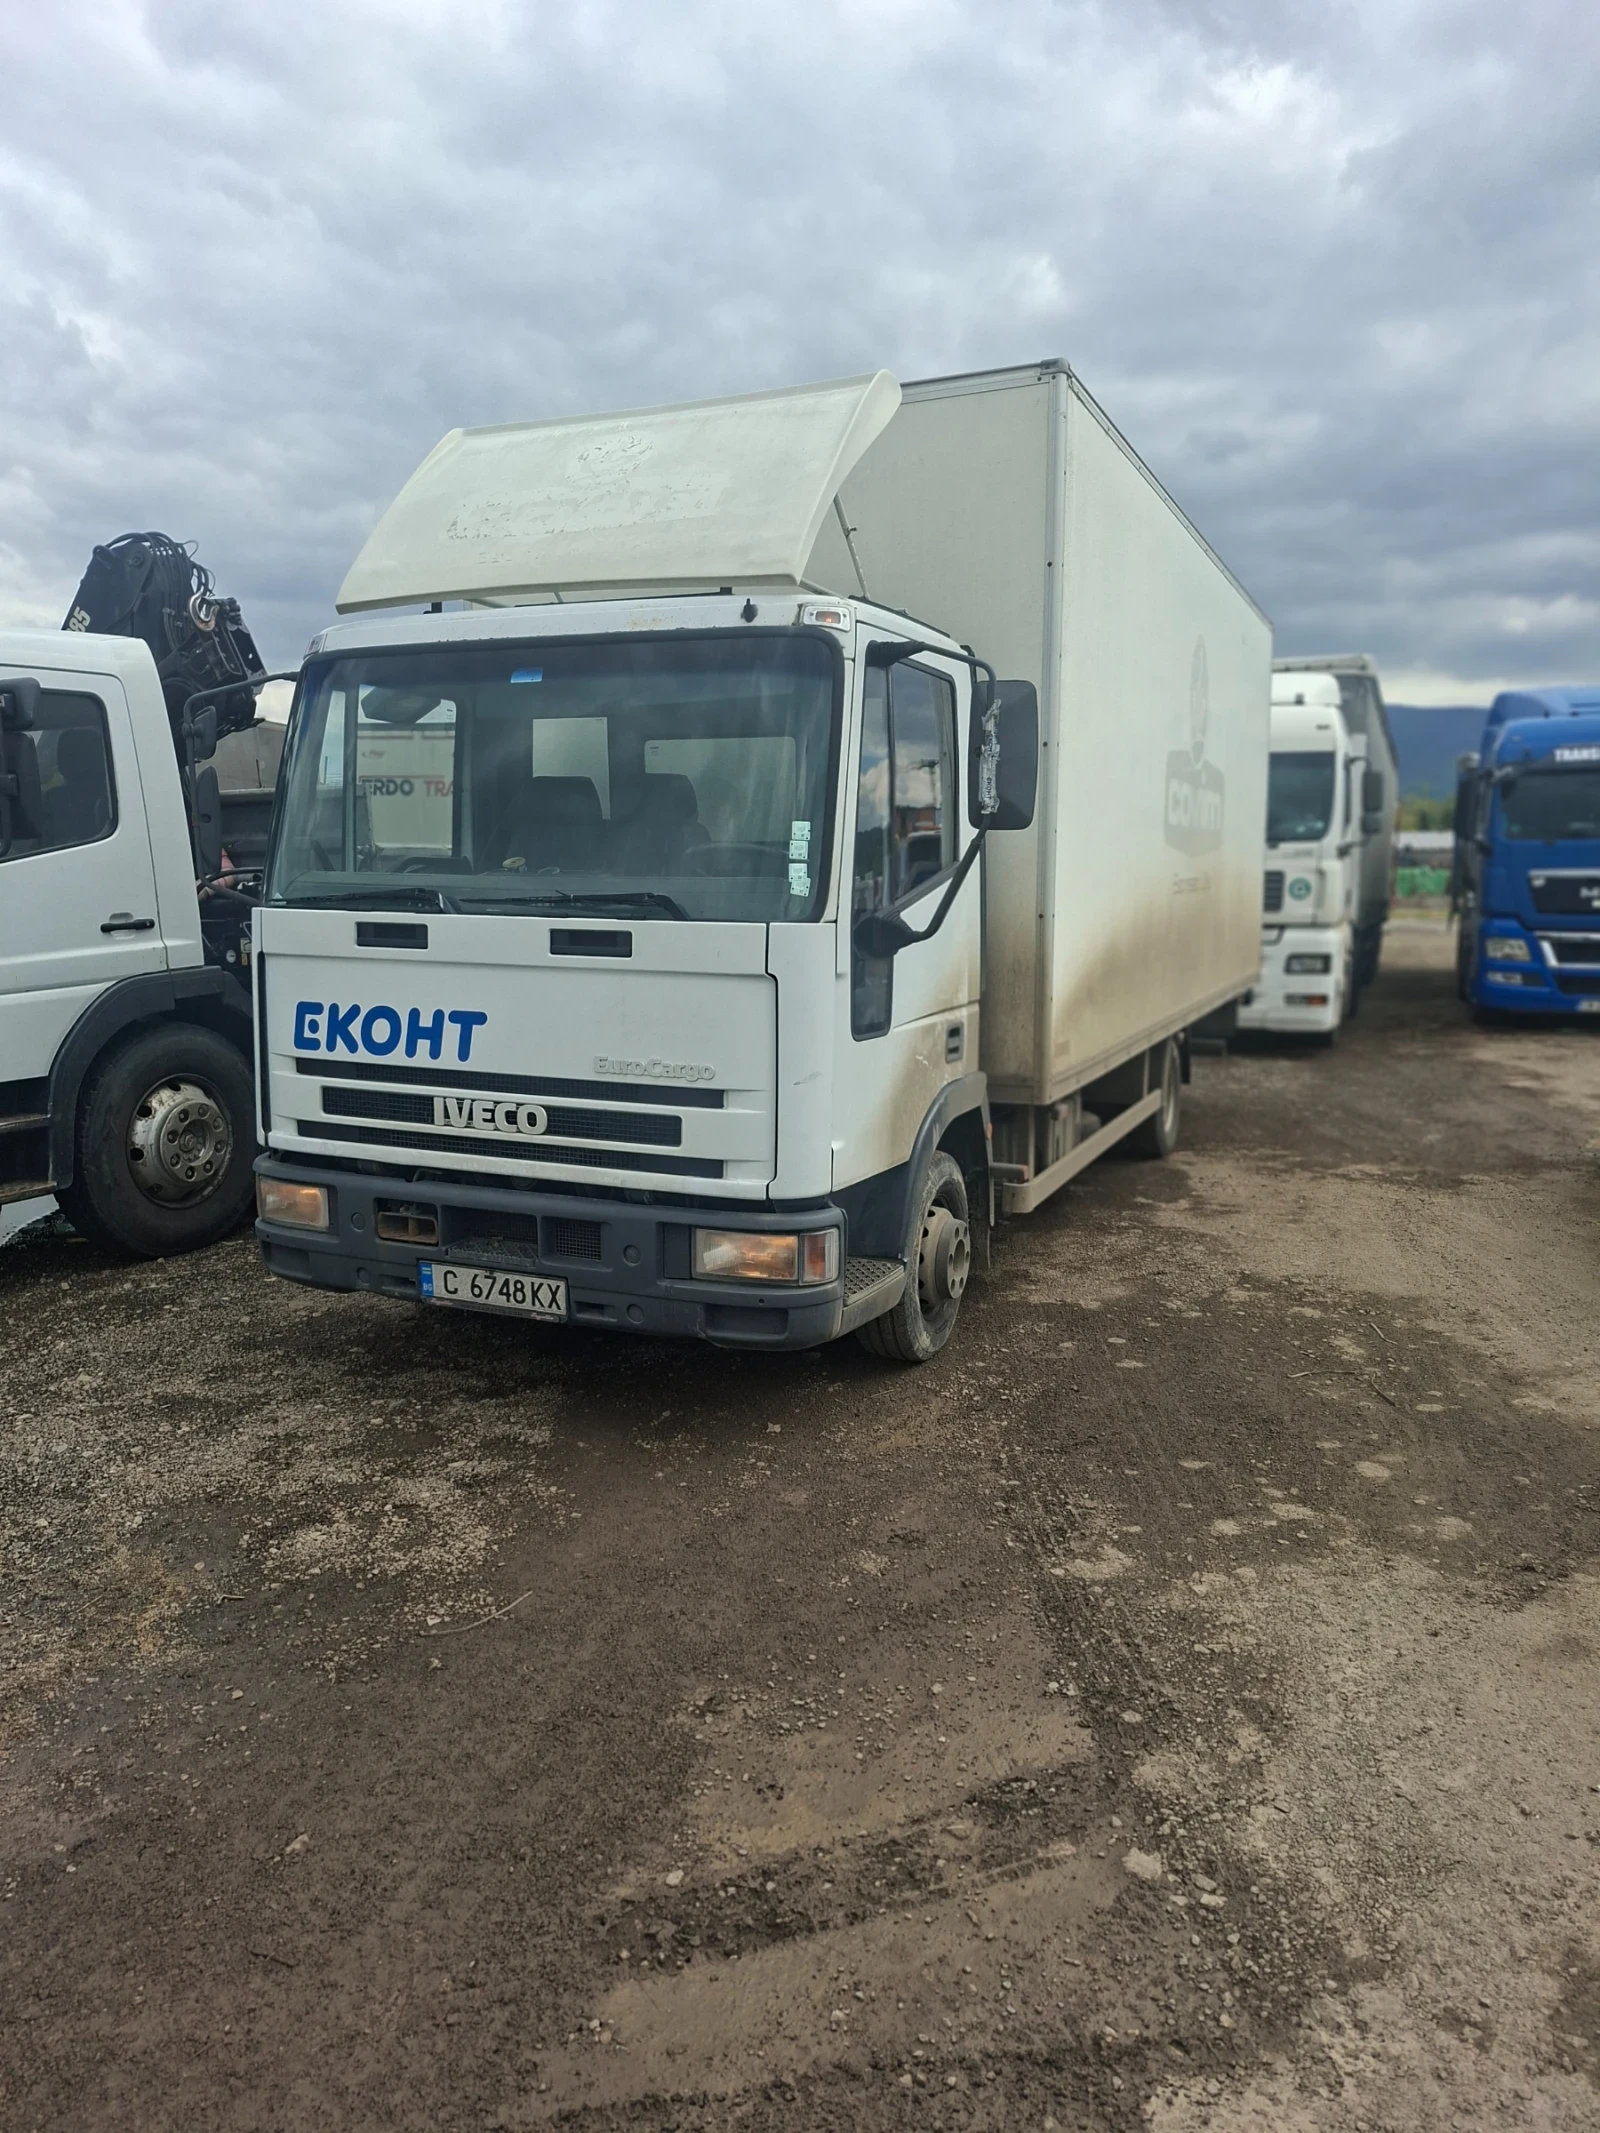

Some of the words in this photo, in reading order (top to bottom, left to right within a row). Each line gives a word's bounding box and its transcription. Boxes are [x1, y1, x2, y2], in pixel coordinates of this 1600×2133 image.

[66, 605, 91, 632] 85
[294, 1001, 488, 1062] ЕКОНТ
[593, 1056, 716, 1082] EuroCargo
[433, 1097, 547, 1134] IVECO
[423, 1282, 433, 1291] BG
[443, 1269, 458, 1295] C
